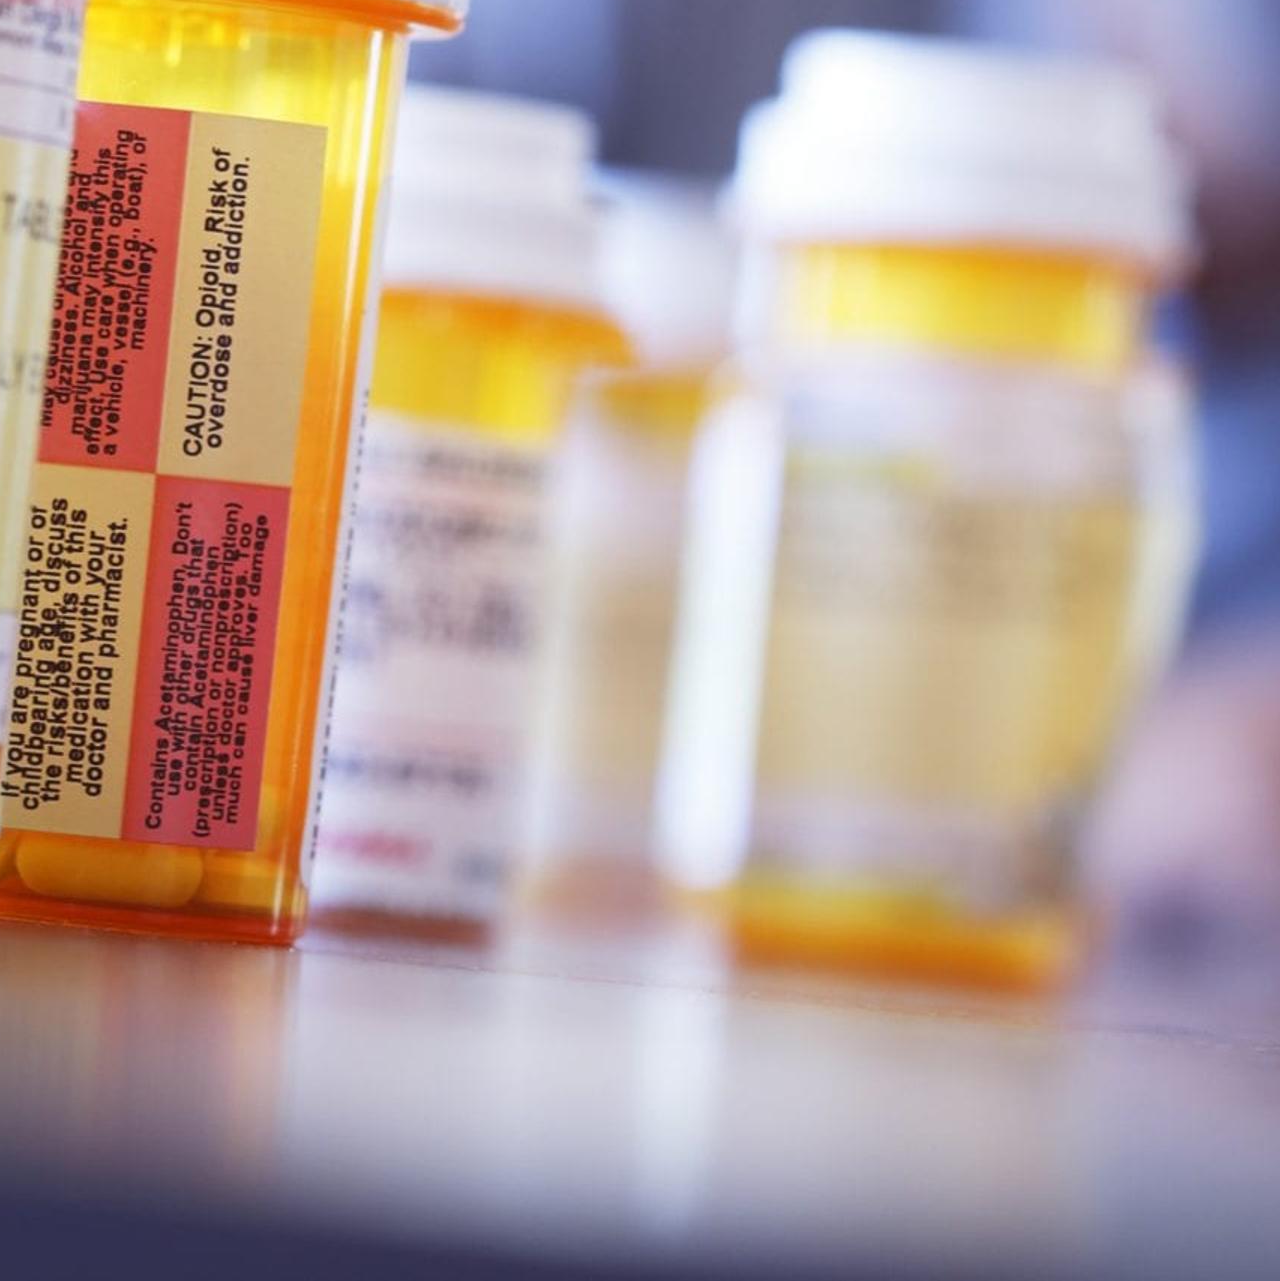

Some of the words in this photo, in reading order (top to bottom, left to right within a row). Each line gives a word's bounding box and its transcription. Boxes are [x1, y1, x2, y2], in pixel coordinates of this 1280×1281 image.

[91, 147, 111, 185] this
[133, 132, 147, 154] or
[211, 146, 231, 172] of
[74, 172, 92, 211] and
[108, 129, 134, 227] operating
[122, 161, 148, 220] boat),
[203, 179, 229, 232] Risk
[82, 190, 110, 278] intensify
[220, 155, 250, 274] addiction.
[63, 218, 88, 296] Alcohol
[100, 233, 120, 288] when
[193, 241, 221, 328] Opioid.
[81, 284, 101, 327] may
[96, 294, 114, 339] care
[113, 283, 132, 350] vessel
[131, 237, 157, 350] machinery.
[216, 282, 237, 326] and
[53, 303, 79, 404] dizziness.
[89, 345, 109, 384] Use
[70, 333, 93, 435] marijuana
[101, 358, 128, 436] vehicle,
[181, 335, 213, 456] CAUTION:
[206, 333, 233, 448] overdose
[103, 443, 116, 455] a
[26, 535, 44, 562] or
[63, 508, 87, 554] this
[84, 530, 106, 586] your
[184, 538, 204, 578] that
[245, 514, 269, 596] damage
[61, 558, 82, 584] of
[95, 516, 128, 658] pharmacist.
[211, 501, 243, 672] nonprescription)
[18, 568, 42, 676] pregnant
[77, 593, 100, 643] with
[178, 584, 201, 643] drugs
[188, 545, 219, 708] Acetaminophen
[225, 569, 247, 672] approves.
[239, 602, 258, 646] liver
[19, 658, 56, 810] childbearing
[38, 496, 68, 593] discuss
[43, 591, 75, 756] risks/benefits
[143, 737, 169, 829] Contains
[170, 501, 193, 554] Don't
[173, 650, 194, 704] other
[11, 685, 30, 723] are
[91, 665, 113, 710] and
[208, 678, 222, 699] or
[216, 678, 237, 745] doctor
[236, 653, 254, 715] cause
[65, 650, 95, 782] medication
[169, 710, 187, 752] with
[231, 722, 246, 759] can
[5, 732, 26, 775] you
[80, 716, 108, 796] doctor
[167, 758, 182, 795] use
[183, 714, 203, 791] contain
[191, 706, 219, 837] (prescription
[0, 780, 20, 797] If
[39, 763, 62, 802] the
[211, 752, 230, 820] unless
[225, 764, 242, 823] much
